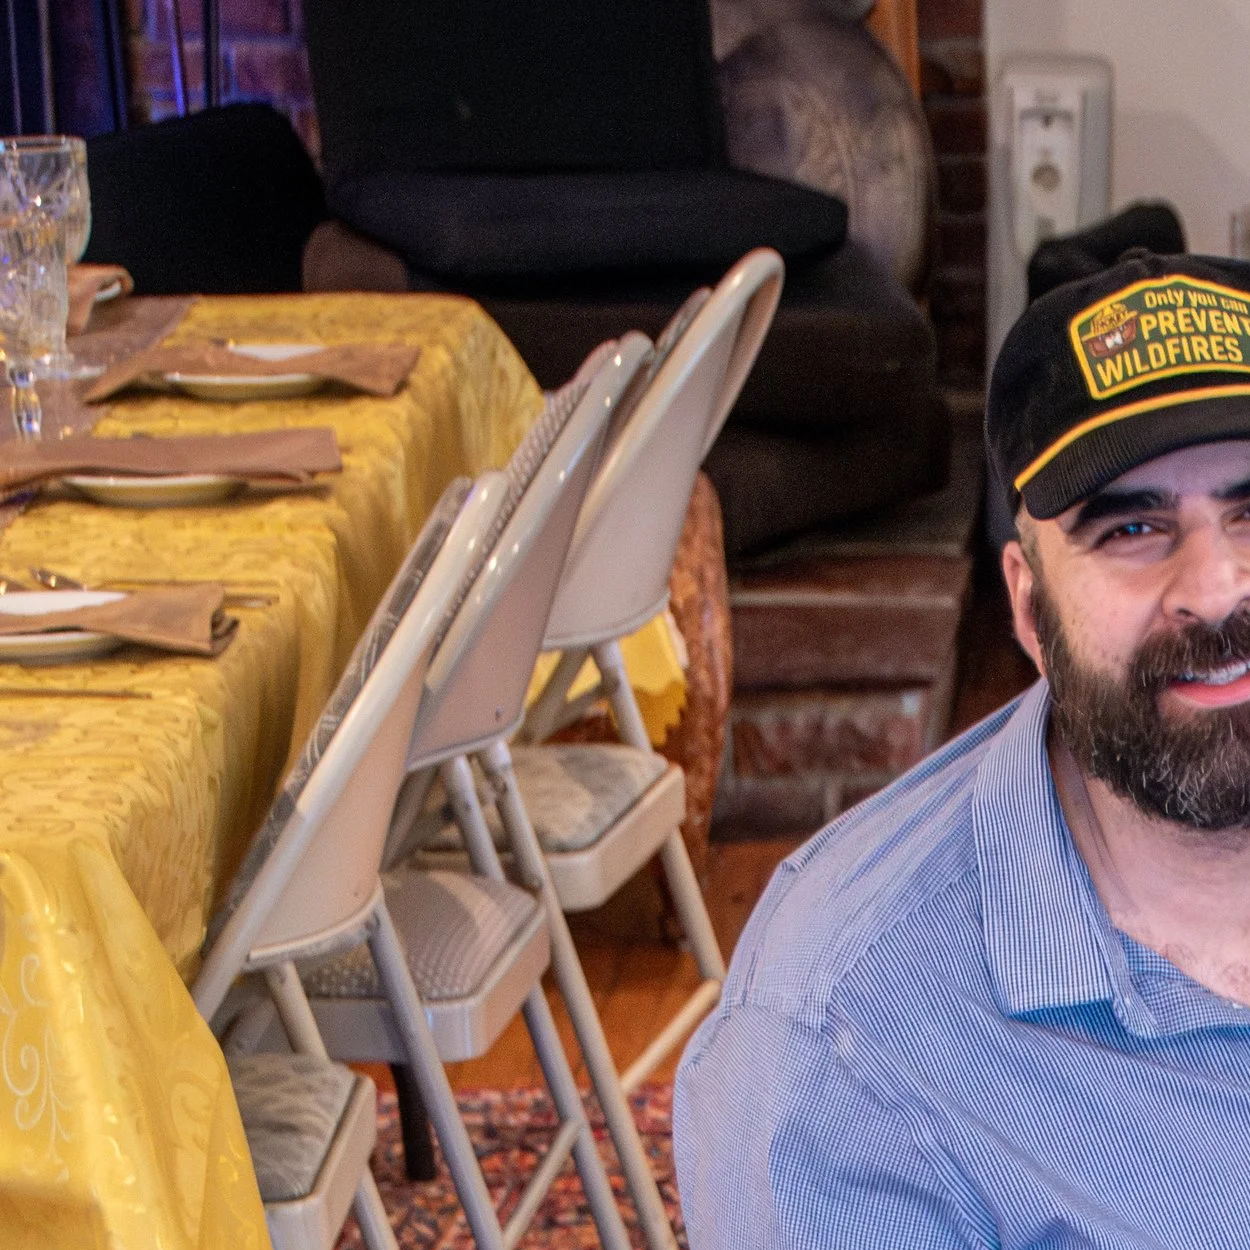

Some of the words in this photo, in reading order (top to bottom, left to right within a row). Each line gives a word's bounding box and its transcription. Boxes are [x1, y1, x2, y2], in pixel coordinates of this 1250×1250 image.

[1144, 289, 1184, 309] Only
[1187, 290, 1217, 308] you
[1221, 295, 1249, 315] can
[1097, 335, 1243, 388] WILDFIRES
